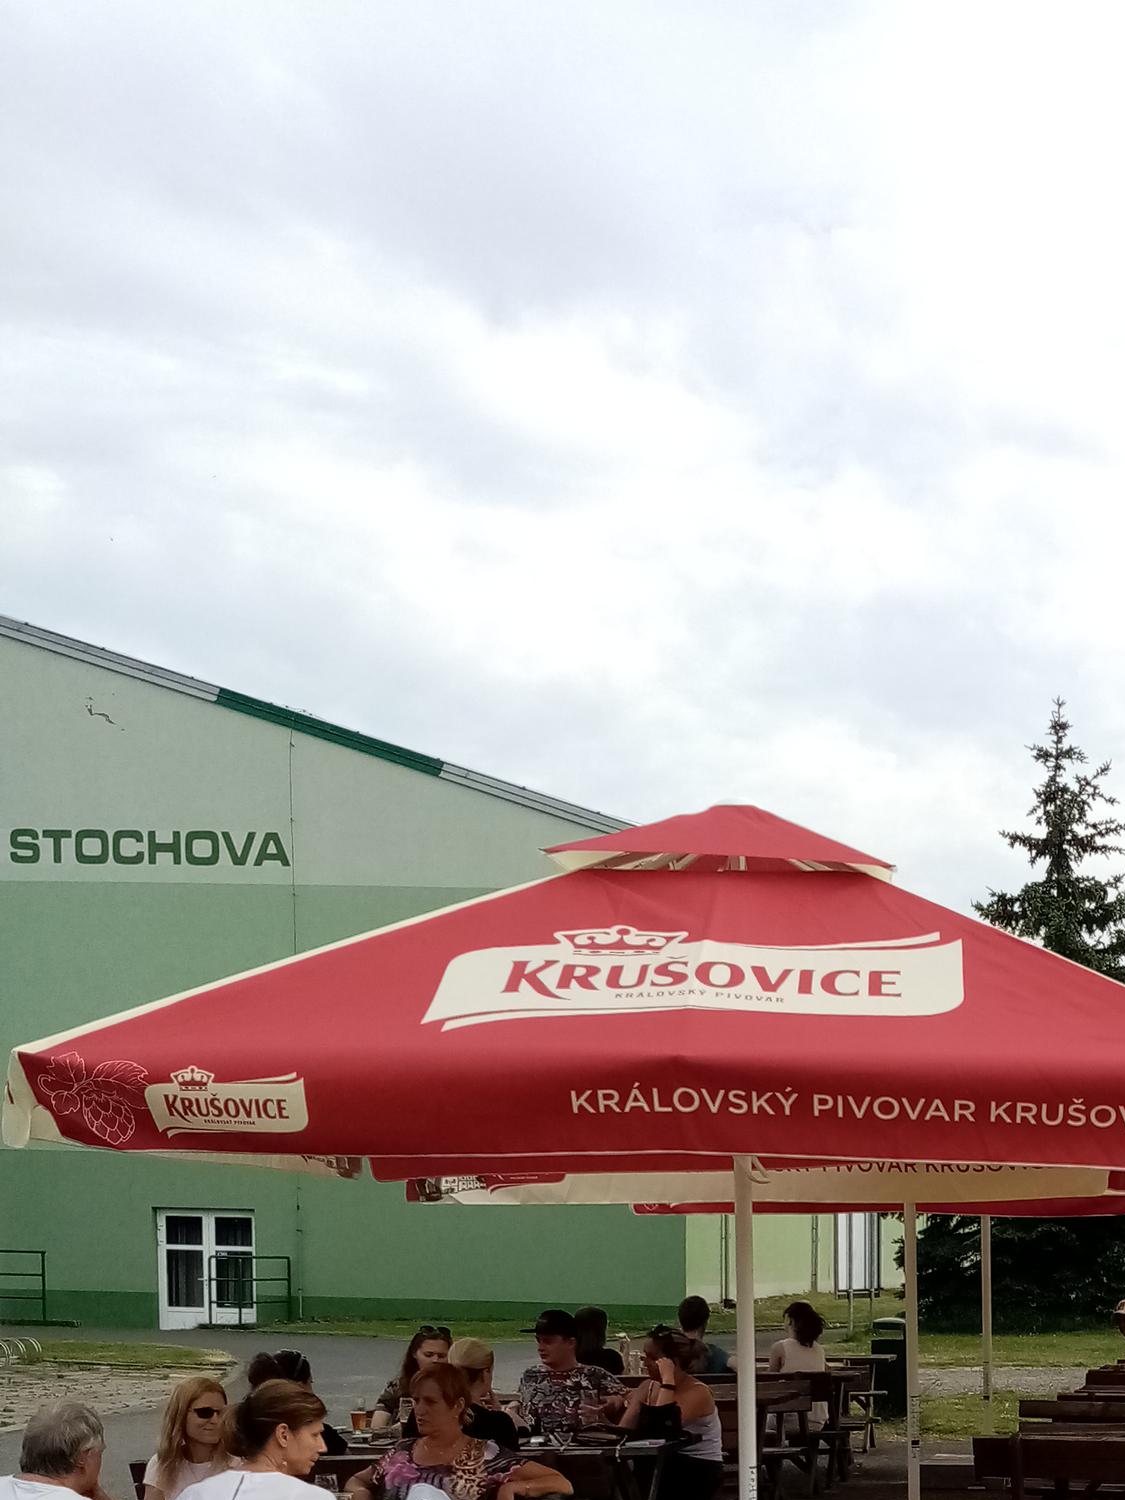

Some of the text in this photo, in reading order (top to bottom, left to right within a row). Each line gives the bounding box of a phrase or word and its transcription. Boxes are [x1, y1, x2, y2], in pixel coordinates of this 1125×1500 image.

[9, 828, 291, 867] STOCHOVA
[501, 956, 902, 1000] KRUŠOVICE
[163, 1092, 290, 1123] KRUŠOVICE
[569, 1082, 799, 1116] KRÁLOVSKÝ
[812, 1093, 976, 1123] PIVOVAR
